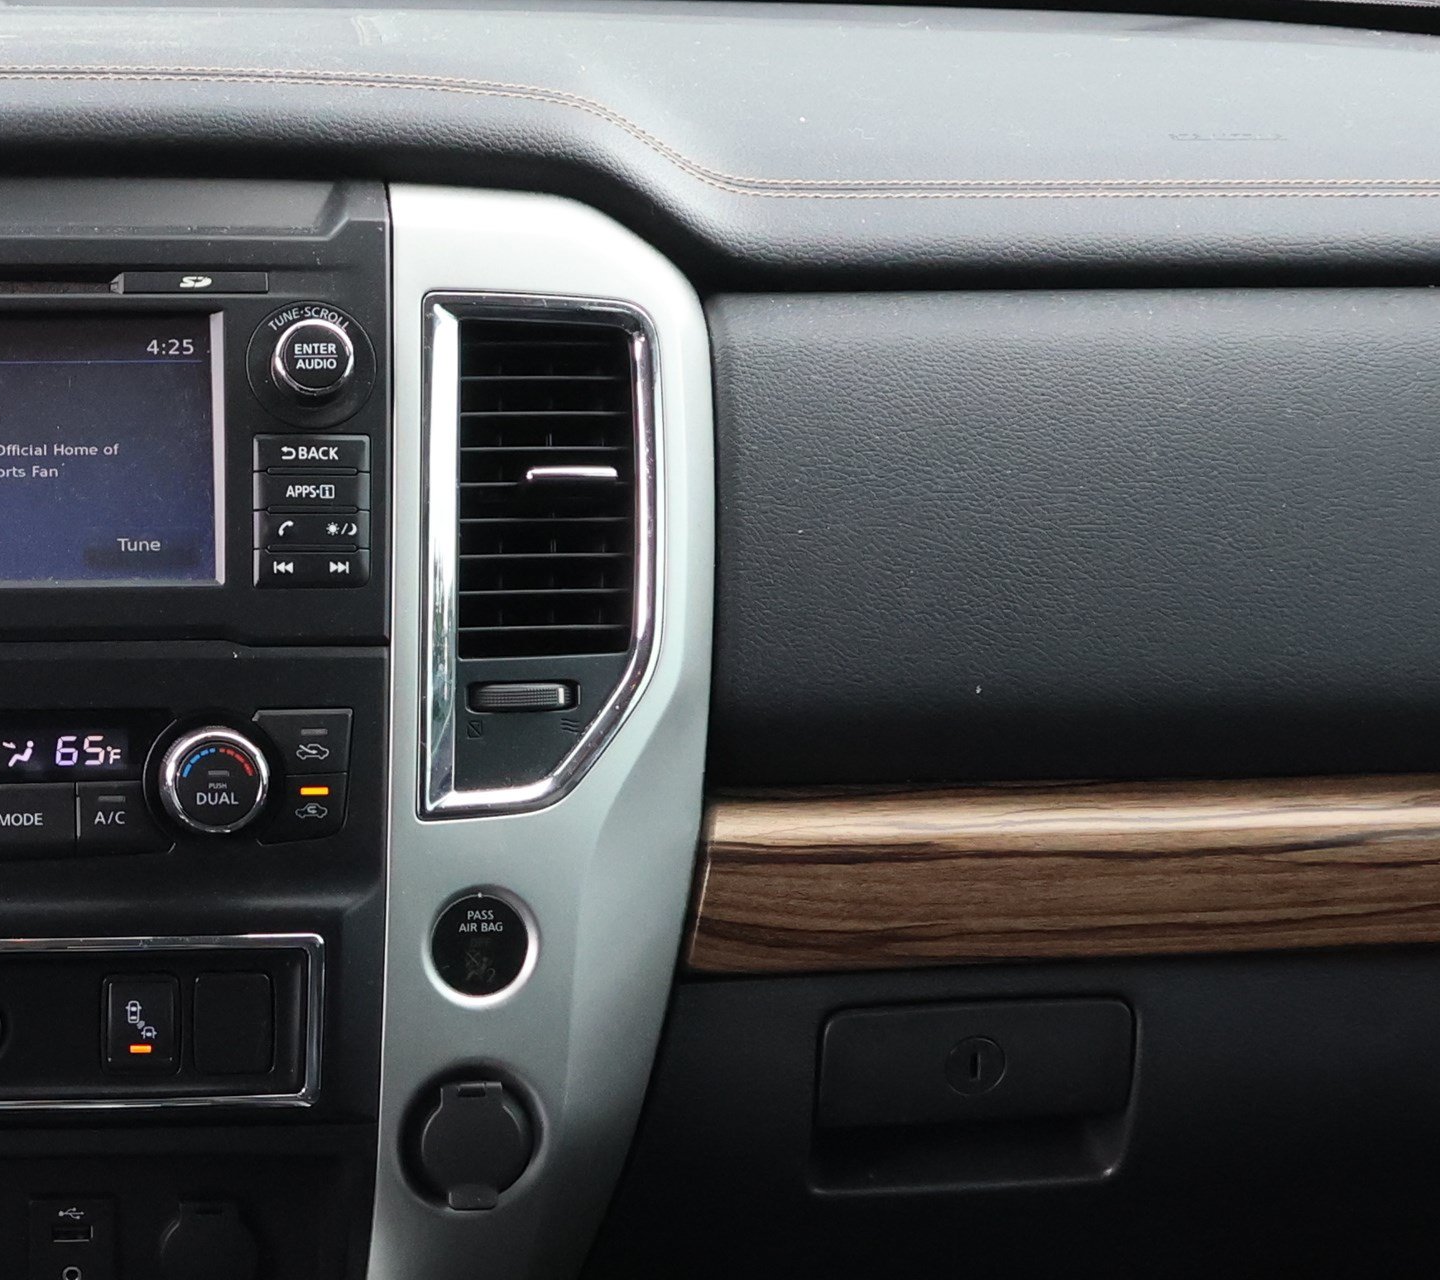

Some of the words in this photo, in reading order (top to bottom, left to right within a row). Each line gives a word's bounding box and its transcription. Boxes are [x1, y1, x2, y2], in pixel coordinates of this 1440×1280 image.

[146, 339, 195, 356] 4:25
[294, 343, 337, 355] ENTER
[296, 358, 337, 370] AUDIO
[54, 443, 98, 456] Home
[103, 442, 119, 456] of
[299, 447, 339, 459] BACK
[31, 465, 58, 479] Fan
[117, 538, 161, 552] Tune
[196, 792, 239, 806] DUAL
[94, 811, 125, 825] A/C
[467, 910, 494, 920] PASS
[459, 922, 478, 933] AIR
[480, 921, 503, 932] BAG
